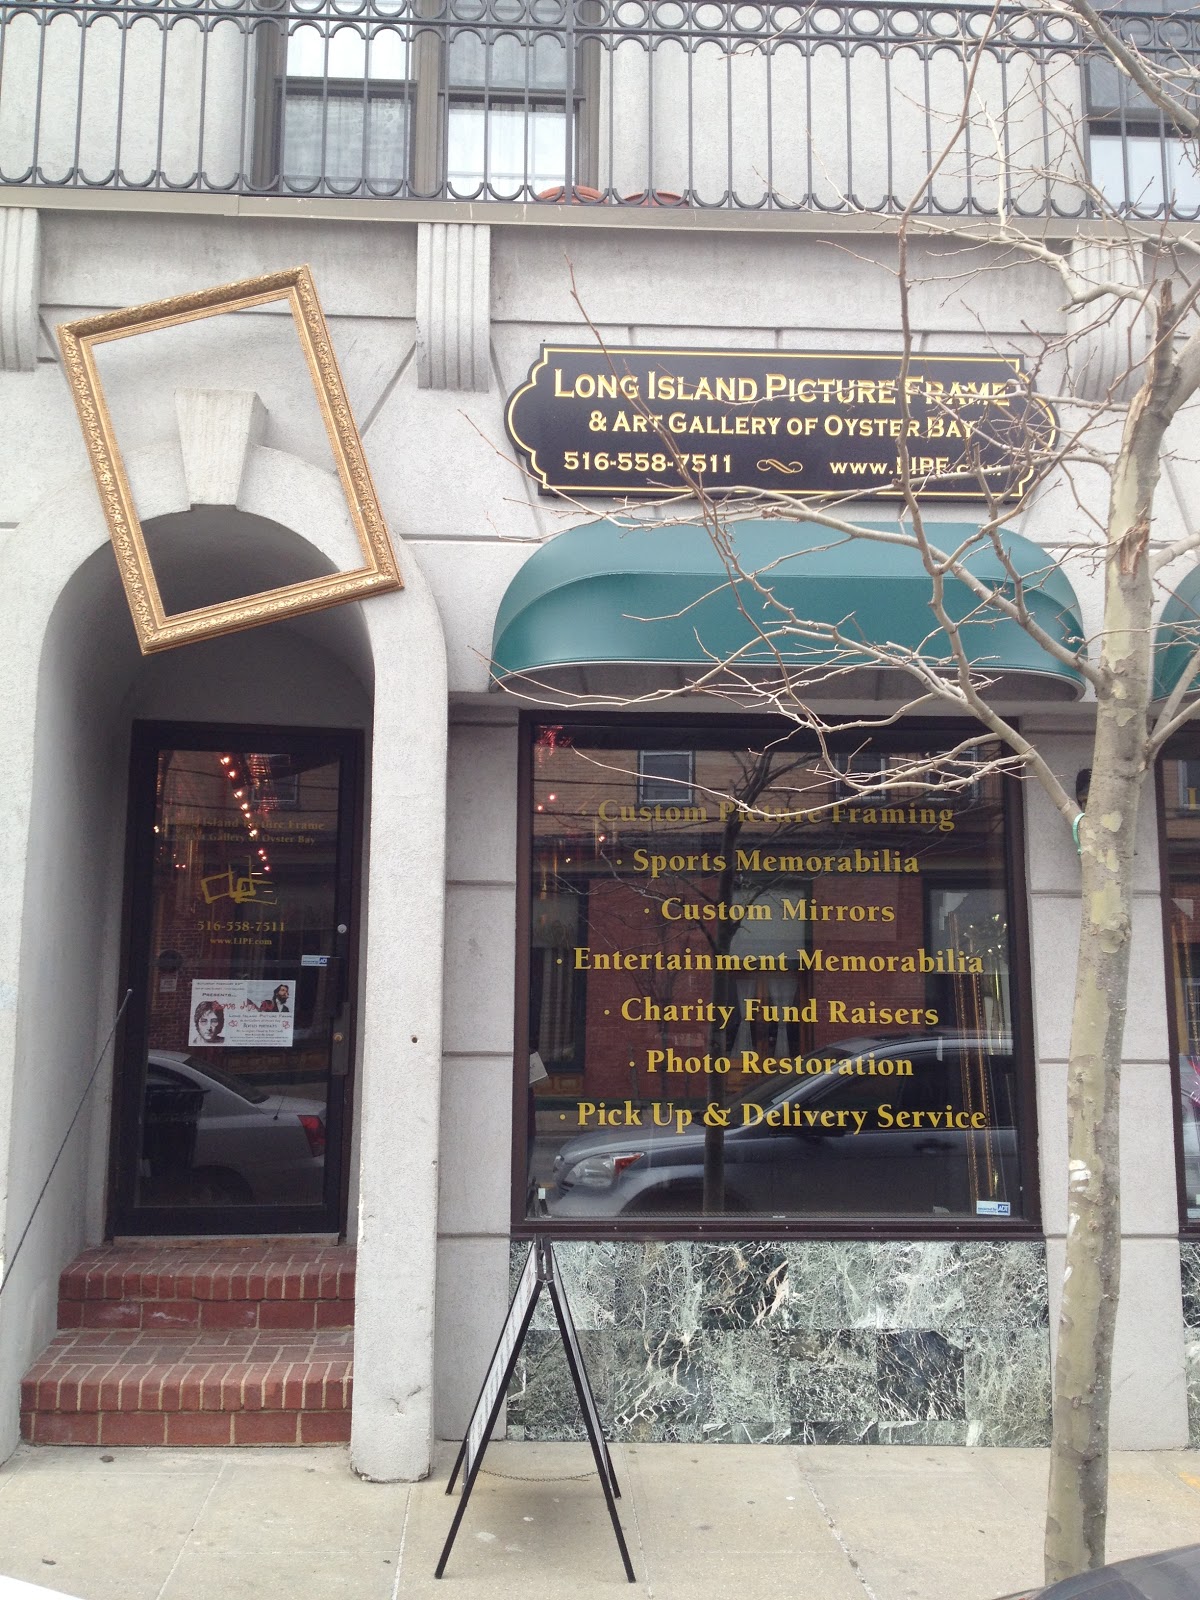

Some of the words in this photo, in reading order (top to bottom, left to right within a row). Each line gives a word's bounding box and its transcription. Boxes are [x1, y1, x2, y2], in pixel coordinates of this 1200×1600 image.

[554, 368, 639, 399] LONG
[648, 371, 758, 401] ISLAND
[765, 373, 896, 405] PICTURE
[589, 410, 607, 432] &
[613, 411, 663, 433] ART
[668, 412, 782, 435] GALLERY
[787, 417, 818, 435] OF
[824, 414, 920, 437] OYSTER
[927, 416, 978, 438] BAY
[564, 451, 731, 473] 516-558-7511
[598, 800, 707, 823] Custom
[718, 801, 822, 824] Picture
[831, 803, 955, 832] Framing
[633, 849, 727, 879] Sports
[736, 849, 920, 873] Memorabilia
[661, 897, 773, 921] Custom
[781, 898, 895, 922] Mirrors
[197, 921, 285, 932] 516-558-7511
[573, 947, 788, 972] Entertainment
[797, 948, 985, 973] Memorabilia
[621, 997, 735, 1029] Charity
[744, 998, 819, 1023] Fund
[828, 1000, 939, 1025] Raisers
[646, 1048, 731, 1074] Photo
[741, 1050, 914, 1076] Restoration
[577, 1101, 643, 1126] Pick
[651, 1102, 693, 1134] Up
[703, 1102, 731, 1127] &
[741, 1101, 868, 1135] Delivery
[877, 1104, 987, 1129] Service
